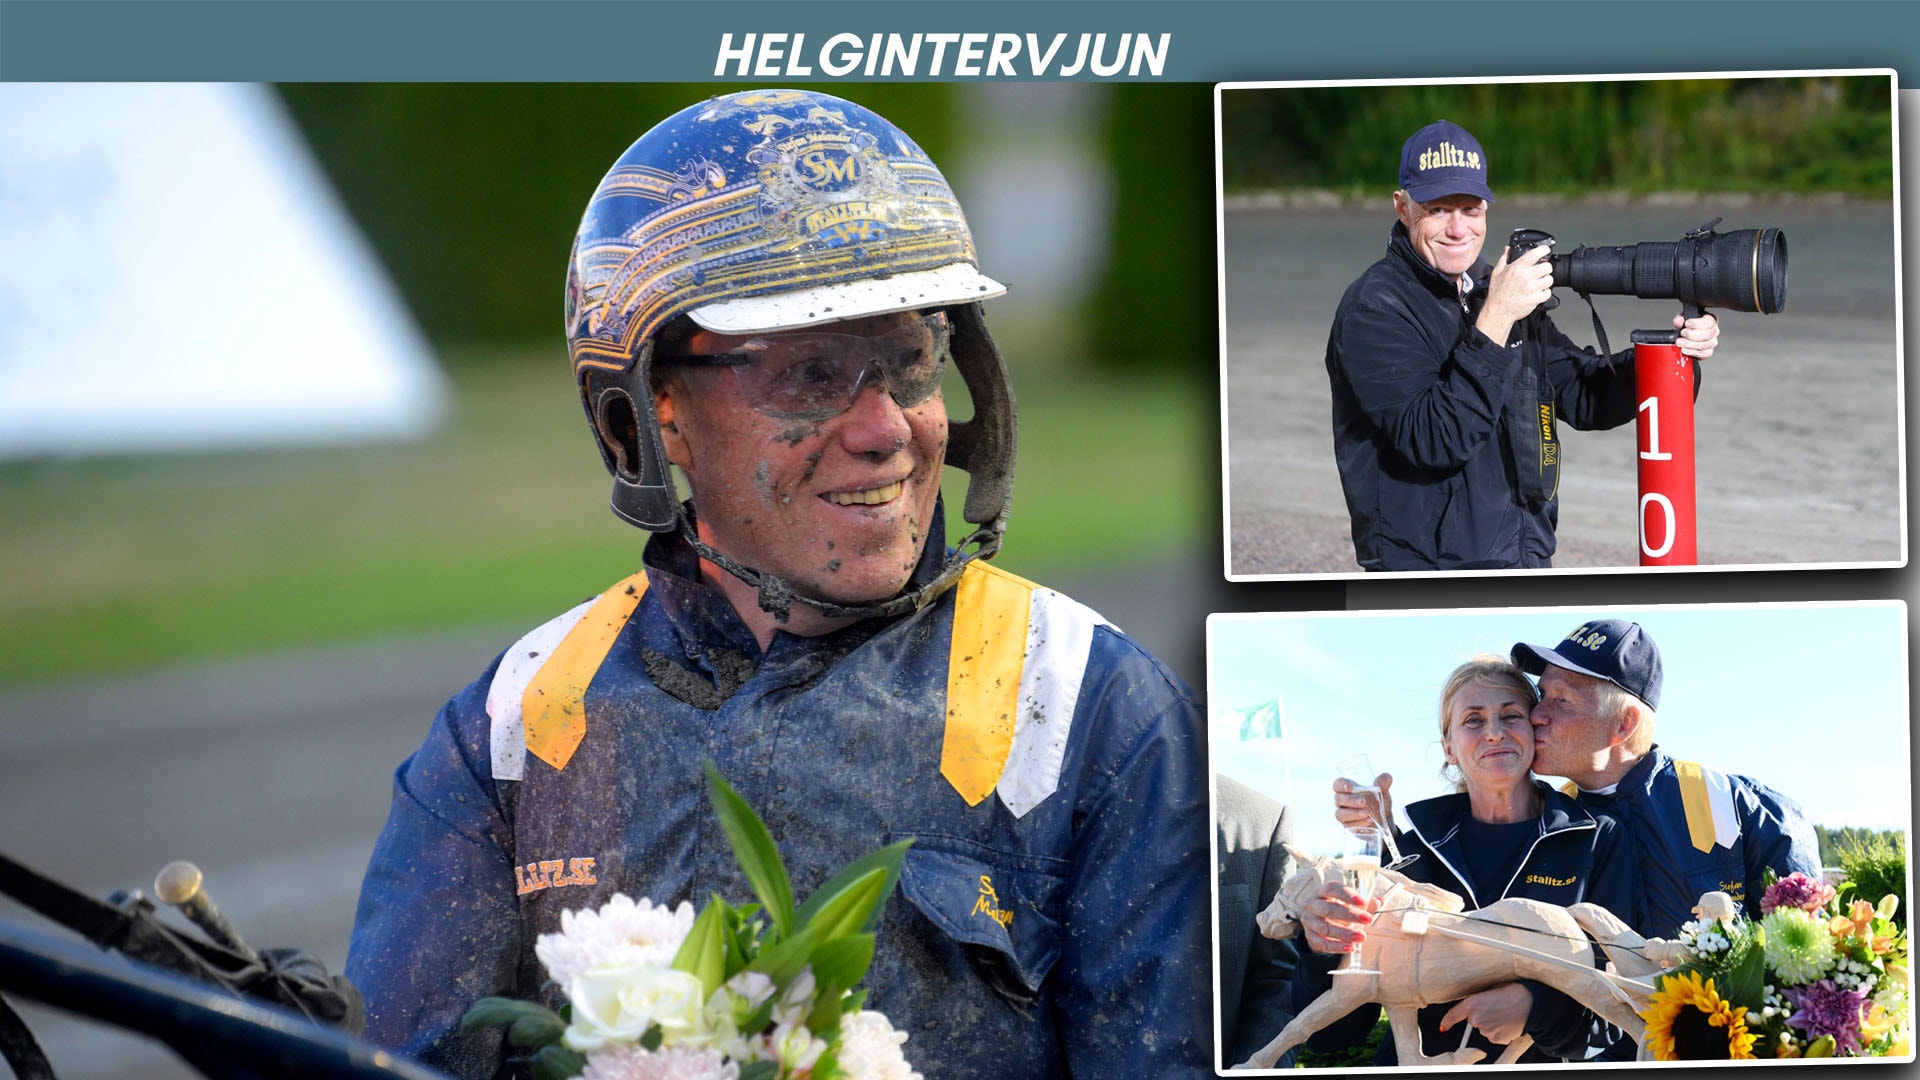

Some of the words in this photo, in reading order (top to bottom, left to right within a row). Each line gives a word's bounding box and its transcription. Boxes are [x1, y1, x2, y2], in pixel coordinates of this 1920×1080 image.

[801, 152, 855, 187] SM
[1419, 141, 1481, 171] stalltz.se
[1540, 404, 1552, 440] Nikon
[1543, 442, 1557, 467] D4
[514, 857, 598, 896] LLTZ.SE
[1525, 874, 1577, 887] stalltz.se
